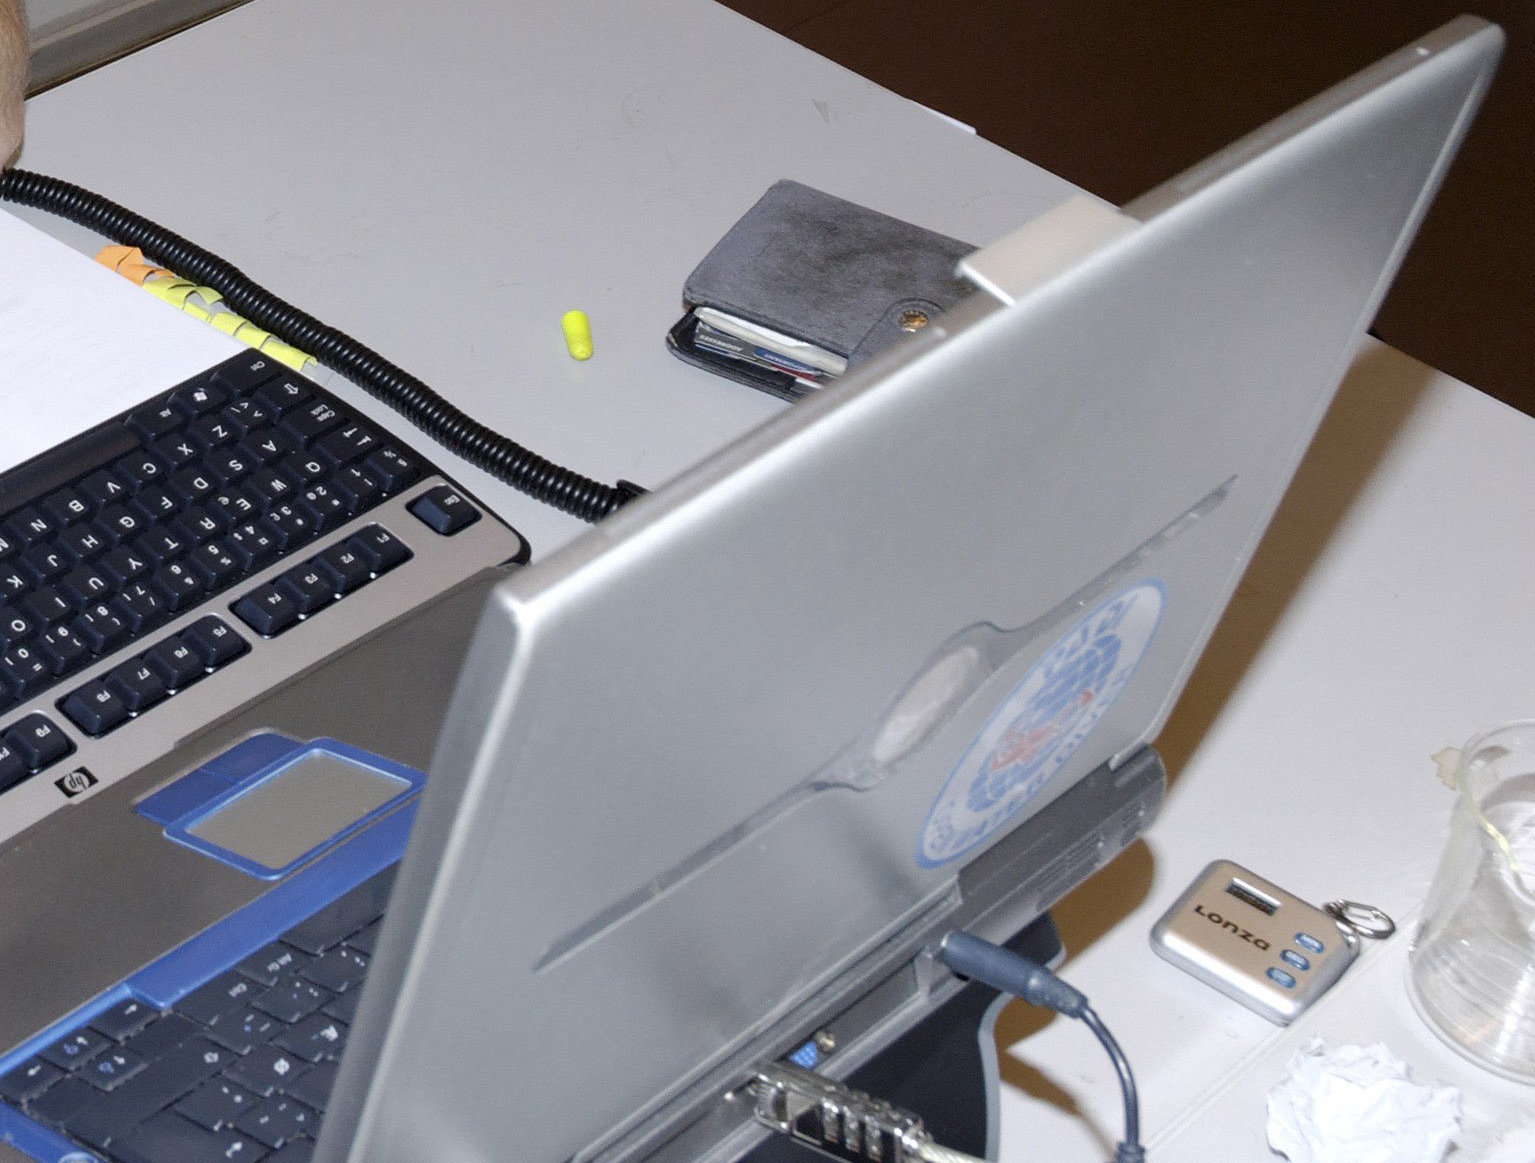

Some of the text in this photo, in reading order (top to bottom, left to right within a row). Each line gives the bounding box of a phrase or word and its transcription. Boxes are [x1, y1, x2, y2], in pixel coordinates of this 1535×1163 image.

[211, 424, 228, 438] Z
[177, 442, 194, 456] X
[261, 439, 277, 452] A
[142, 462, 157, 475] C
[228, 459, 244, 472] S
[304, 461, 321, 473] Q
[106, 481, 122, 494] V
[193, 476, 209, 490] D
[270, 478, 288, 492] W
[68, 499, 85, 513] B
[160, 496, 174, 510] F
[235, 497, 252, 511] E
[30, 518, 48, 533] N
[118, 515, 136, 529] G
[199, 516, 216, 530] R
[81, 534, 99, 549] H
[164, 537, 179, 550] T
[47, 554, 58, 567] J
[128, 557, 143, 571] Y
[6, 574, 24, 589] K
[88, 576, 105, 590] U
[54, 596, 67, 608] I
[10, 619, 27, 633] O
[65, 769, 87, 795] hp
[1194, 904, 1270, 951] Lonza
